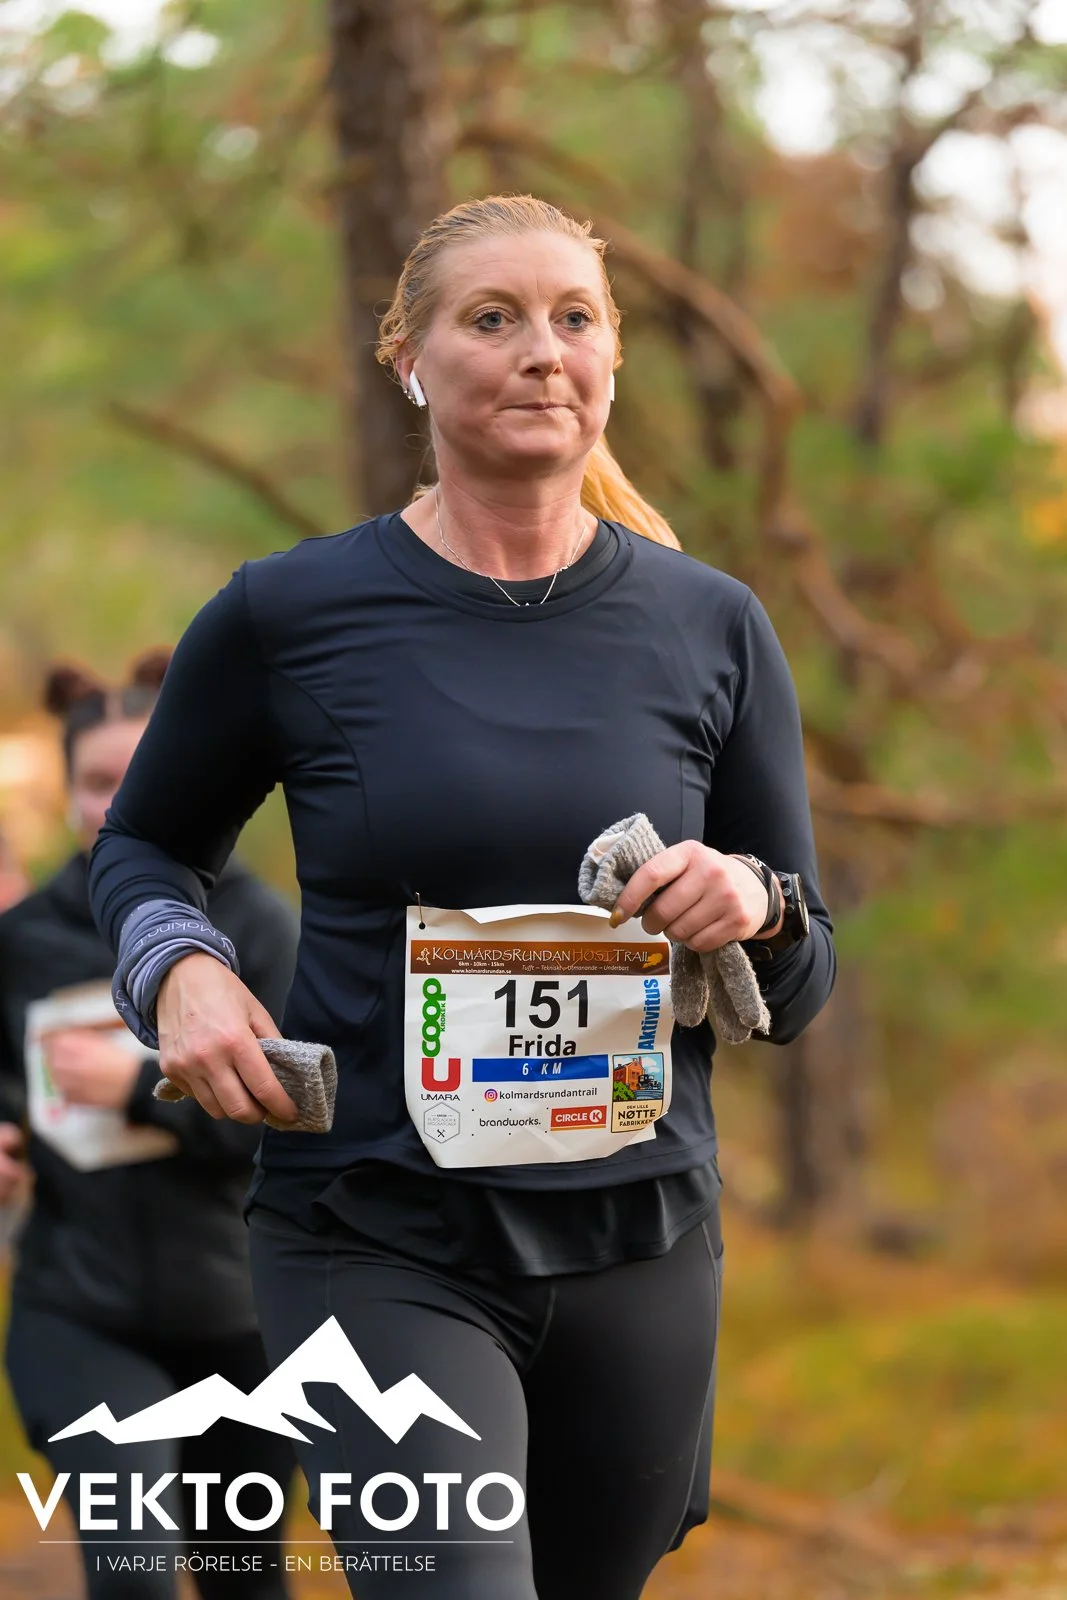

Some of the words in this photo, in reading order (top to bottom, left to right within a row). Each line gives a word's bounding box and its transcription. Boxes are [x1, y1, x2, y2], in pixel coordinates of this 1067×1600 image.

[494, 979, 589, 1029] 151
[422, 977, 447, 1058] coop
[637, 978, 661, 1051] Aktivitus
[508, 1034, 577, 1057] Frida
[522, 1062, 529, 1076] 6
[420, 1093, 461, 1101] UMARA
[499, 1087, 598, 1100] kolmardsrundantrail
[555, 1112, 588, 1123] CIRCLE
[591, 1110, 602, 1122] K
[618, 1109, 657, 1120] NØTTE
